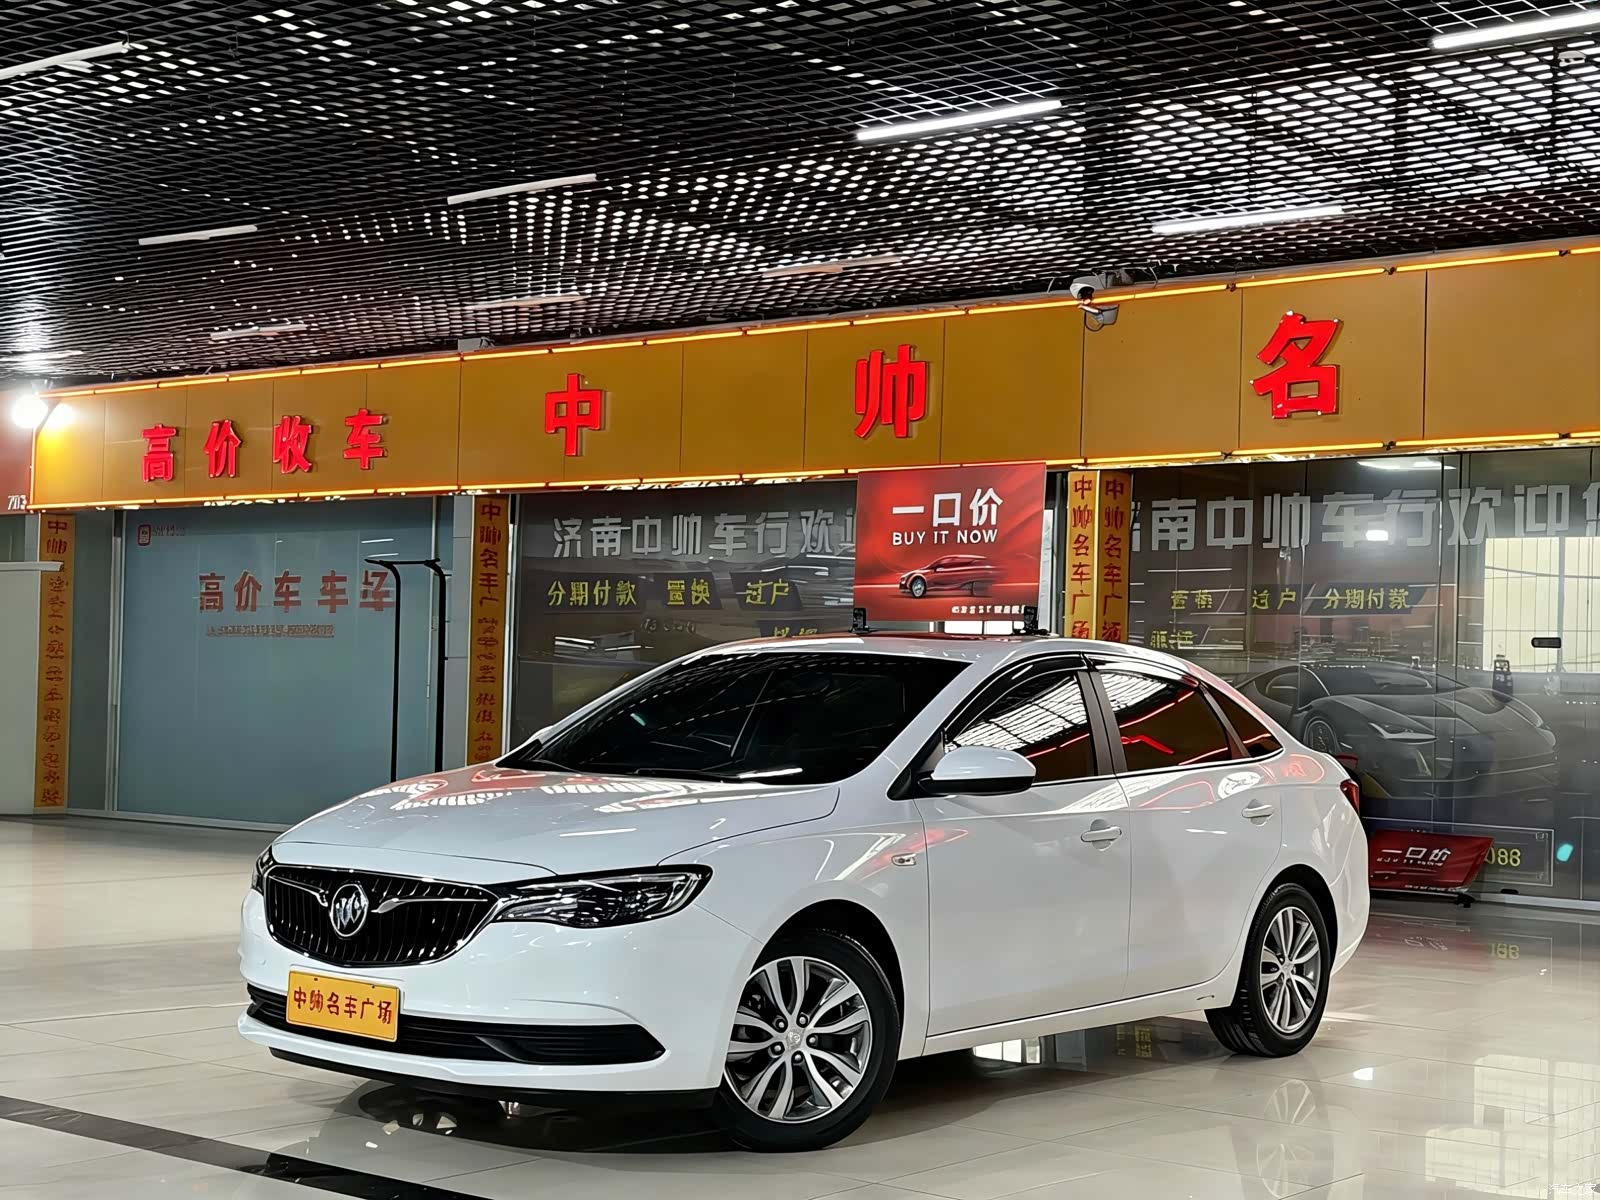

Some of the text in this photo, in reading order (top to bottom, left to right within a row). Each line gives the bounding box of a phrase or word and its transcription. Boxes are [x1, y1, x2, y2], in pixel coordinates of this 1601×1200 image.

[141, 409, 388, 482] 高价收车
[892, 487, 1003, 527] 一口价
[1131, 481, 1600, 552] 南中帅车行欢迎
[892, 529, 998, 545] BUY IT NOW
[1382, 848, 1451, 862] 一口价
